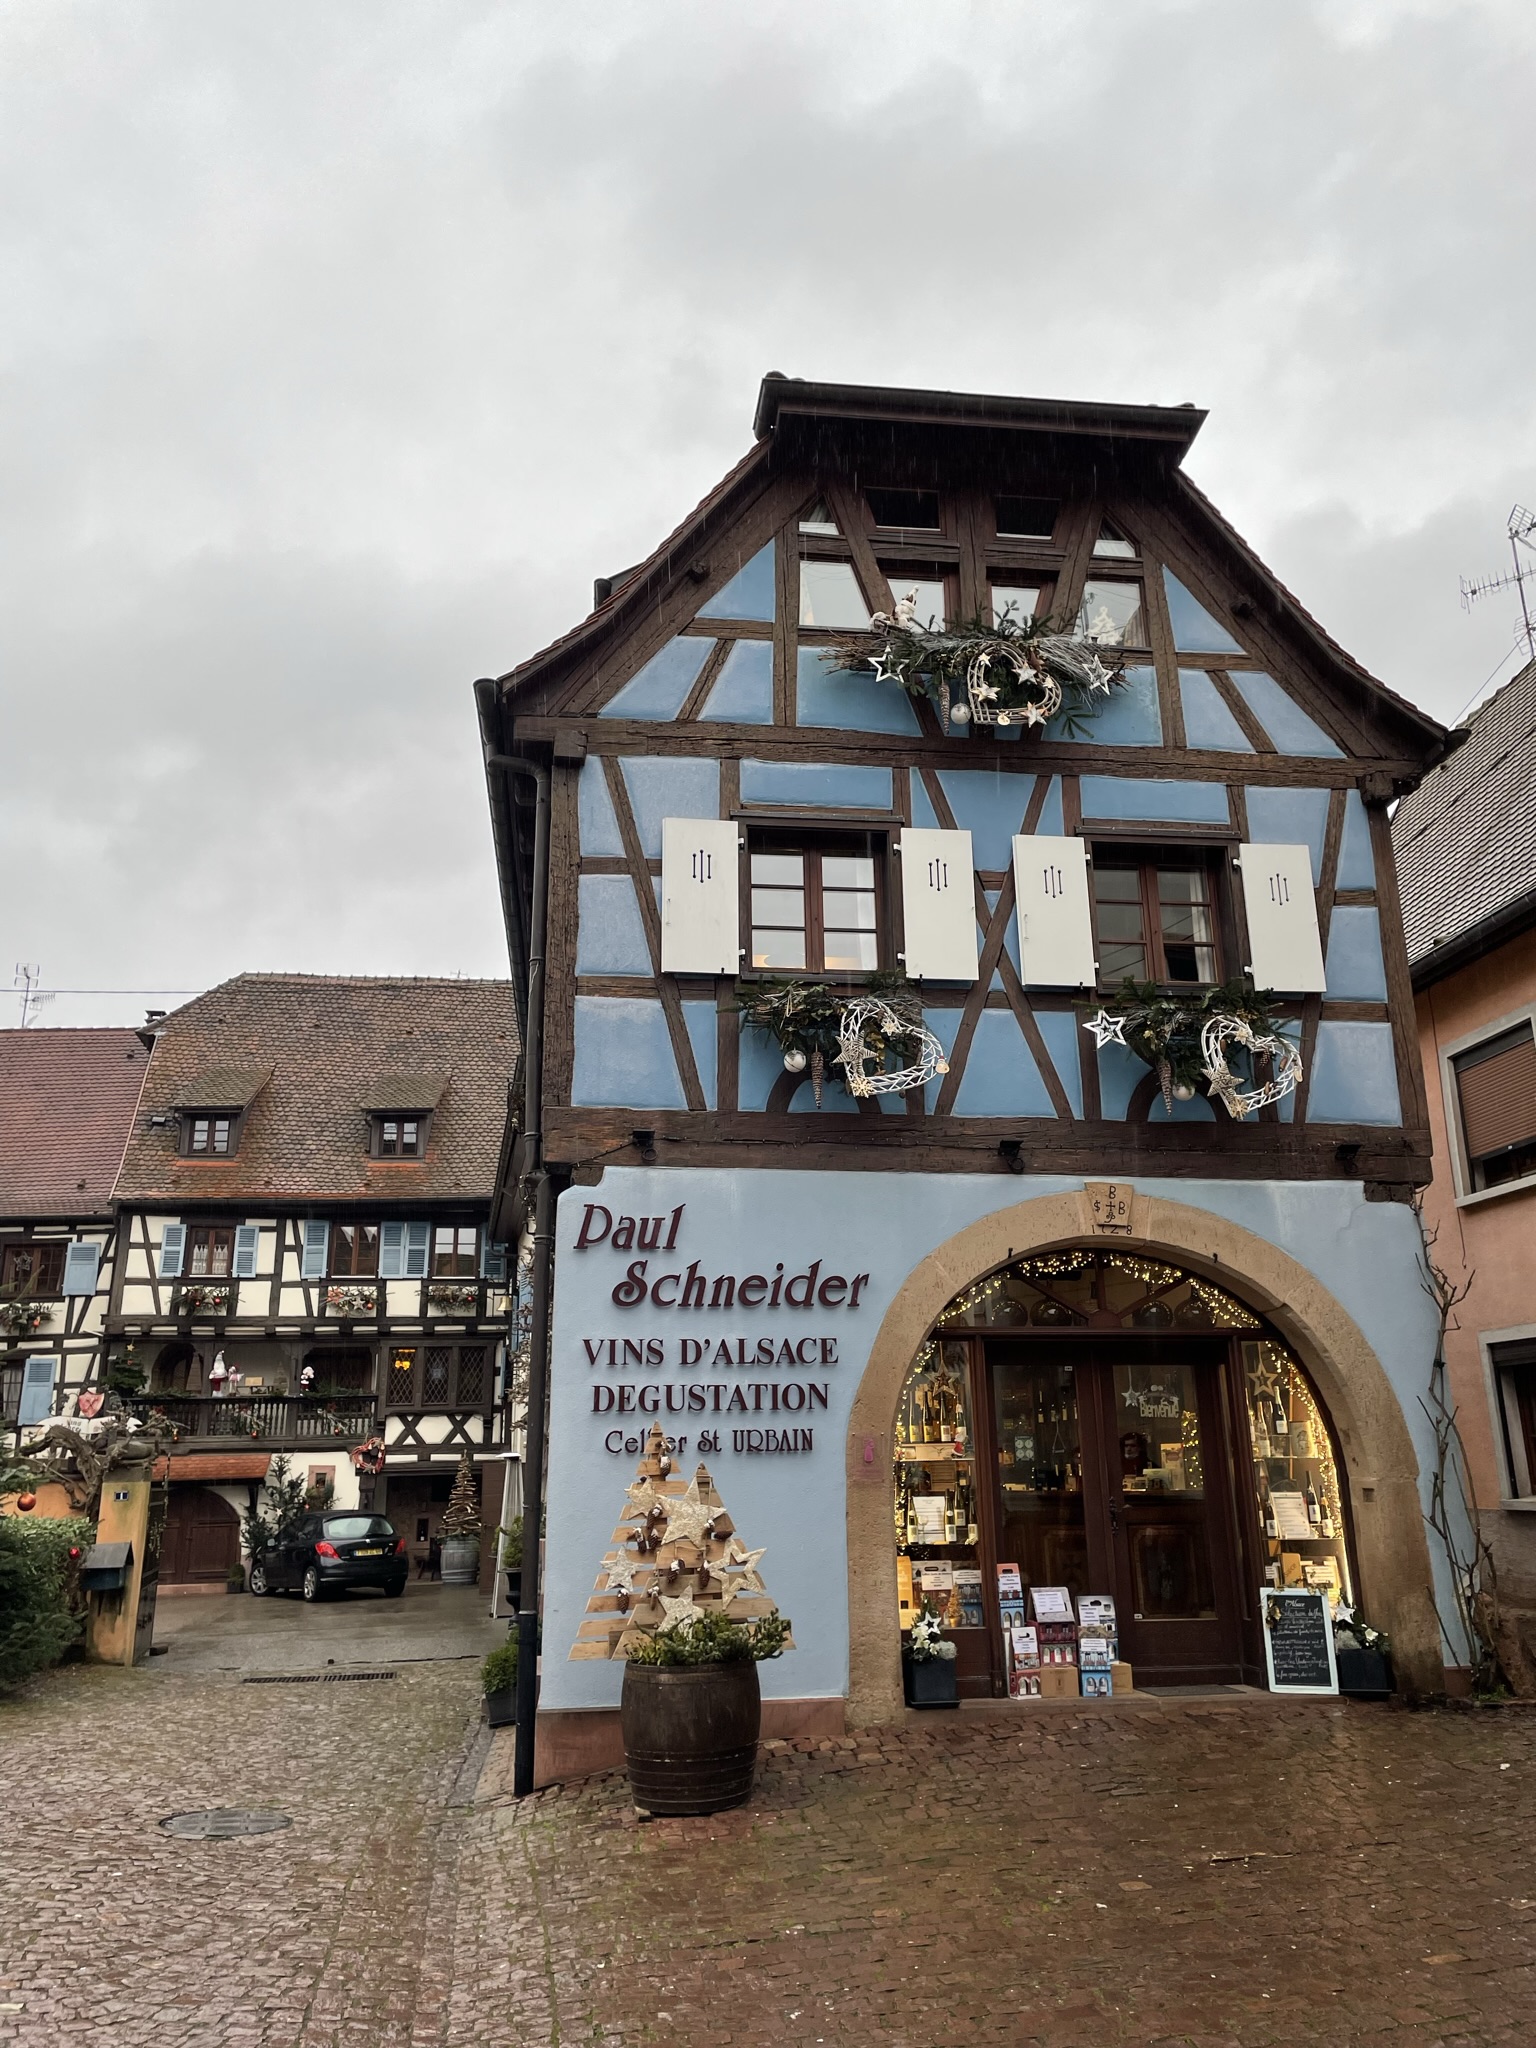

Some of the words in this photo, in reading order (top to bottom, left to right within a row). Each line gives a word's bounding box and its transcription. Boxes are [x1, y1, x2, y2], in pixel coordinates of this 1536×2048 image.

[1108, 1185, 1117, 1199] B
[573, 1203, 687, 1250] Paul
[611, 1258, 870, 1308] Schneider
[582, 1338, 665, 1366] VINS
[679, 1337, 839, 1365] D'ALSACE
[590, 1382, 830, 1413] DEGUSTATION
[605, 1428, 688, 1454] Celer
[697, 1429, 722, 1452] St
[732, 1428, 814, 1453] URBAIN
